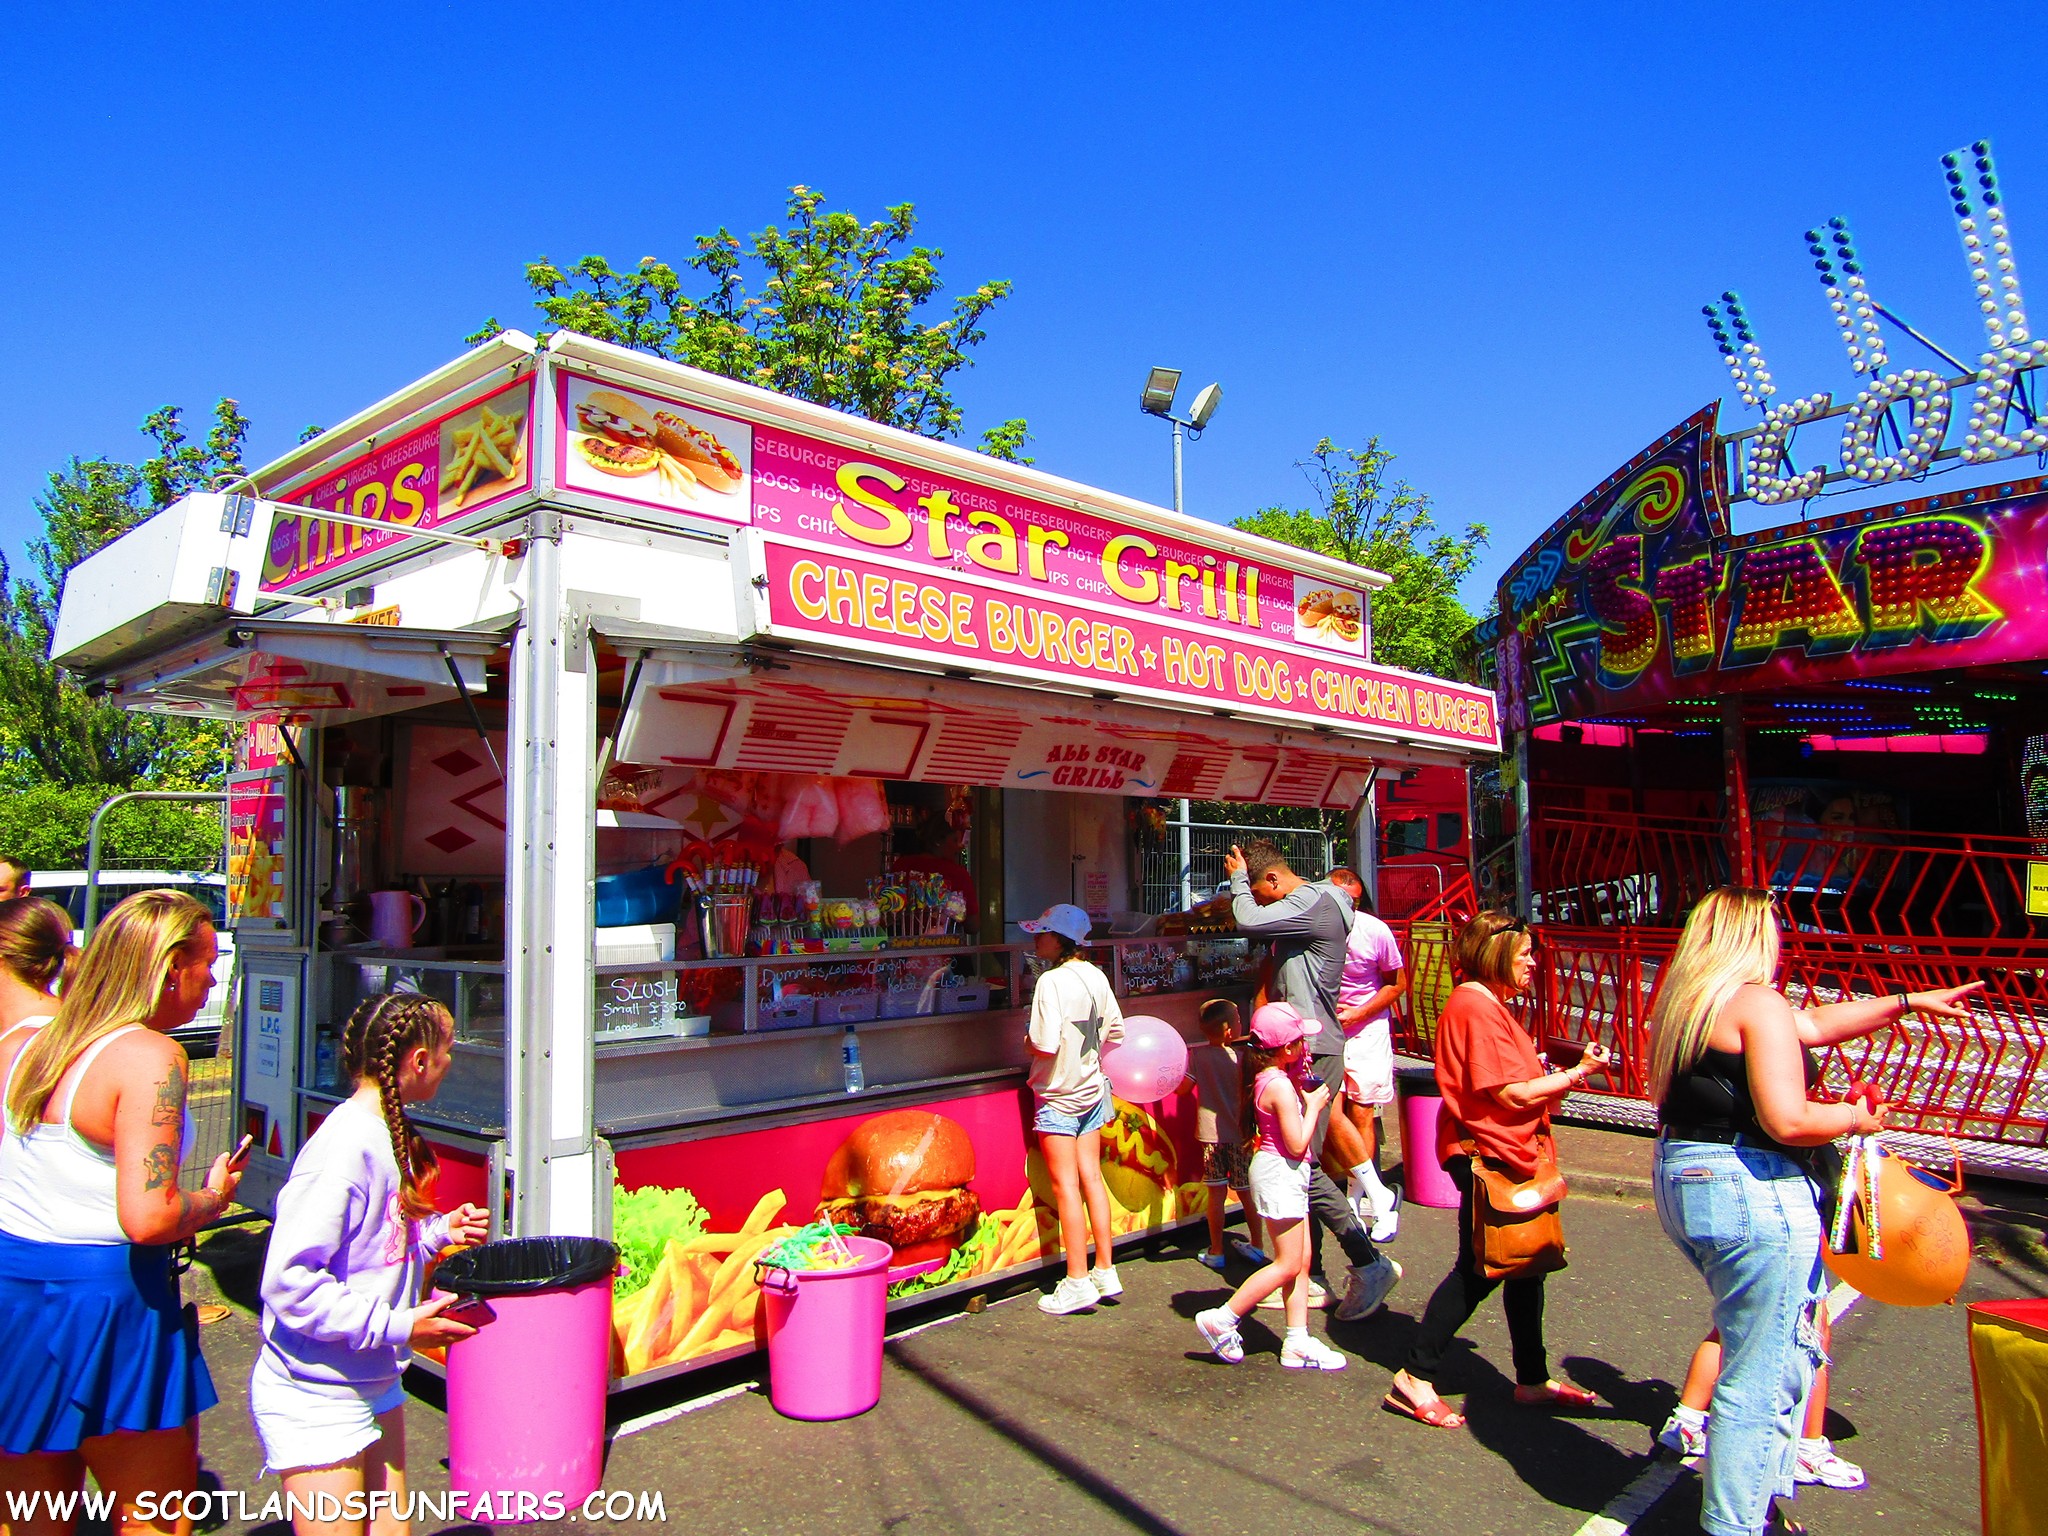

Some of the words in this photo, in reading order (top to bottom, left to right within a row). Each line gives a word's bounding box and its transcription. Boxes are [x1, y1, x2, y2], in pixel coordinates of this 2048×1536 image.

[907, 506, 929, 524] HO
[1067, 546, 1094, 564] HOT
[1005, 503, 1112, 543] CHEESEBURGERS
[831, 462, 1070, 582] Star
[1101, 534, 1260, 629] Grill
[1047, 570, 1070, 587] IPS
[1075, 577, 1113, 596] CHIPS
[788, 559, 980, 650] CHEESE
[986, 599, 1140, 677] BURGER
[1162, 635, 1227, 692] HOT
[1232, 651, 1293, 705] DOG
[1310, 667, 1413, 725] CHICKEN
[1414, 688, 1493, 739] BURGER
[1046, 744, 1091, 763] ALL
[1094, 745, 1146, 772] STAR
[1052, 765, 1126, 790] GRILL
[611, 978, 679, 1002] SLUSH
[603, 1002, 640, 1017] Small
